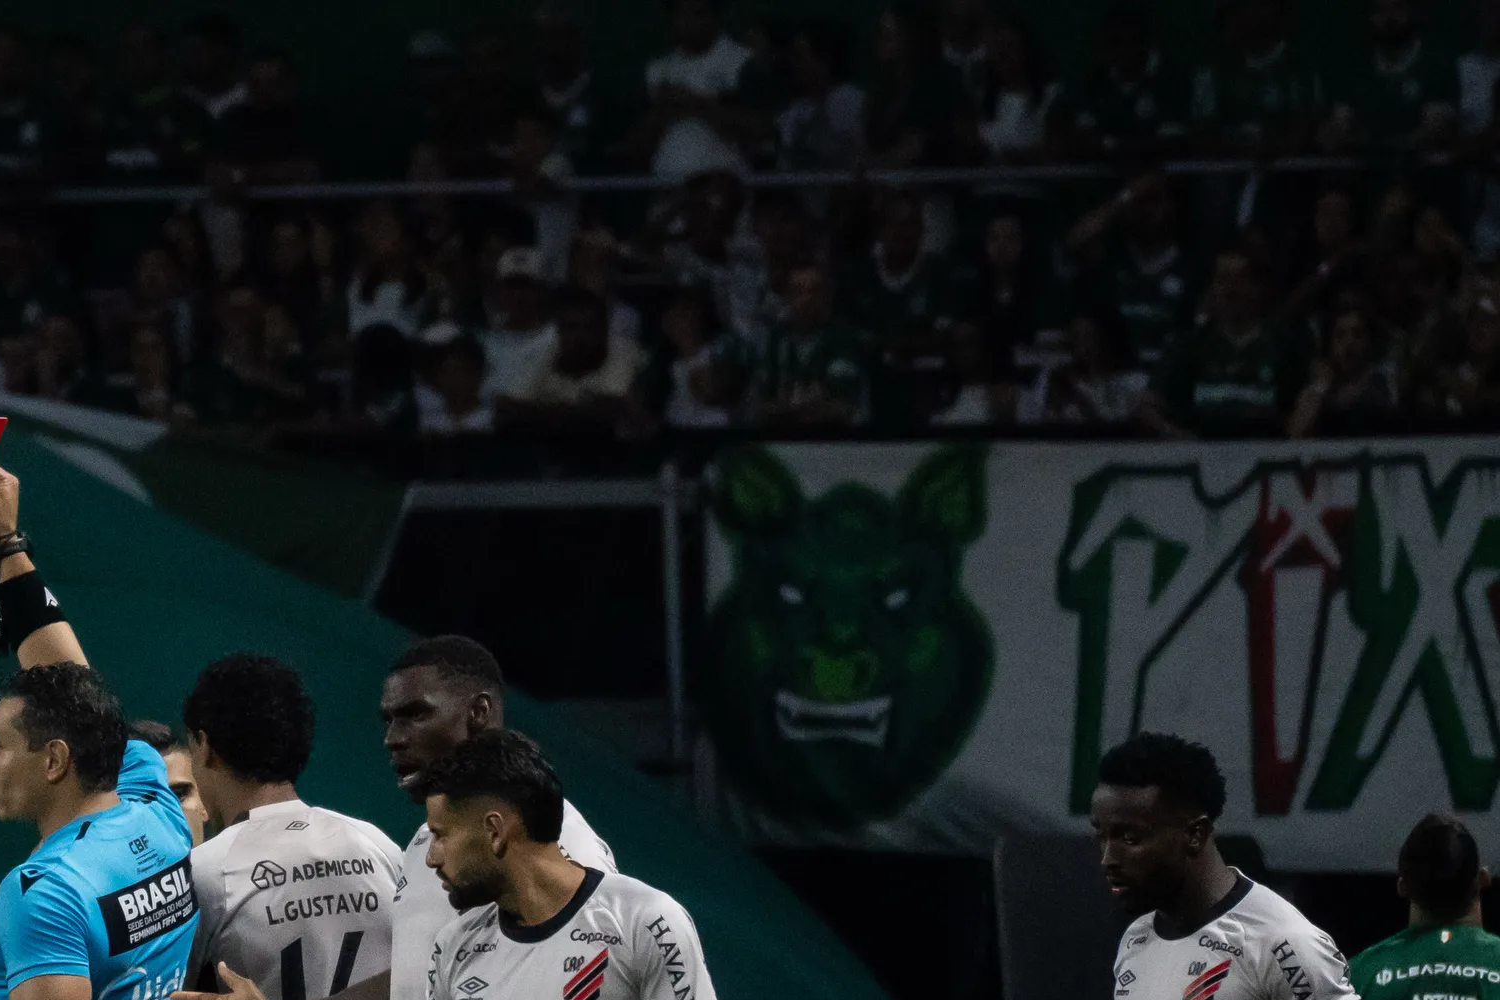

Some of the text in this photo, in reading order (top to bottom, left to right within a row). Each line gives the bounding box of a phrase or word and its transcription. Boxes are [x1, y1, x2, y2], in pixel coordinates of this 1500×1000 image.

[128, 834, 149, 855] CBF
[291, 858, 376, 883] ADEMICON
[117, 867, 190, 922] BRASIL
[265, 891, 379, 926] L.GUSTAVO
[570, 928, 622, 945] Copacol
